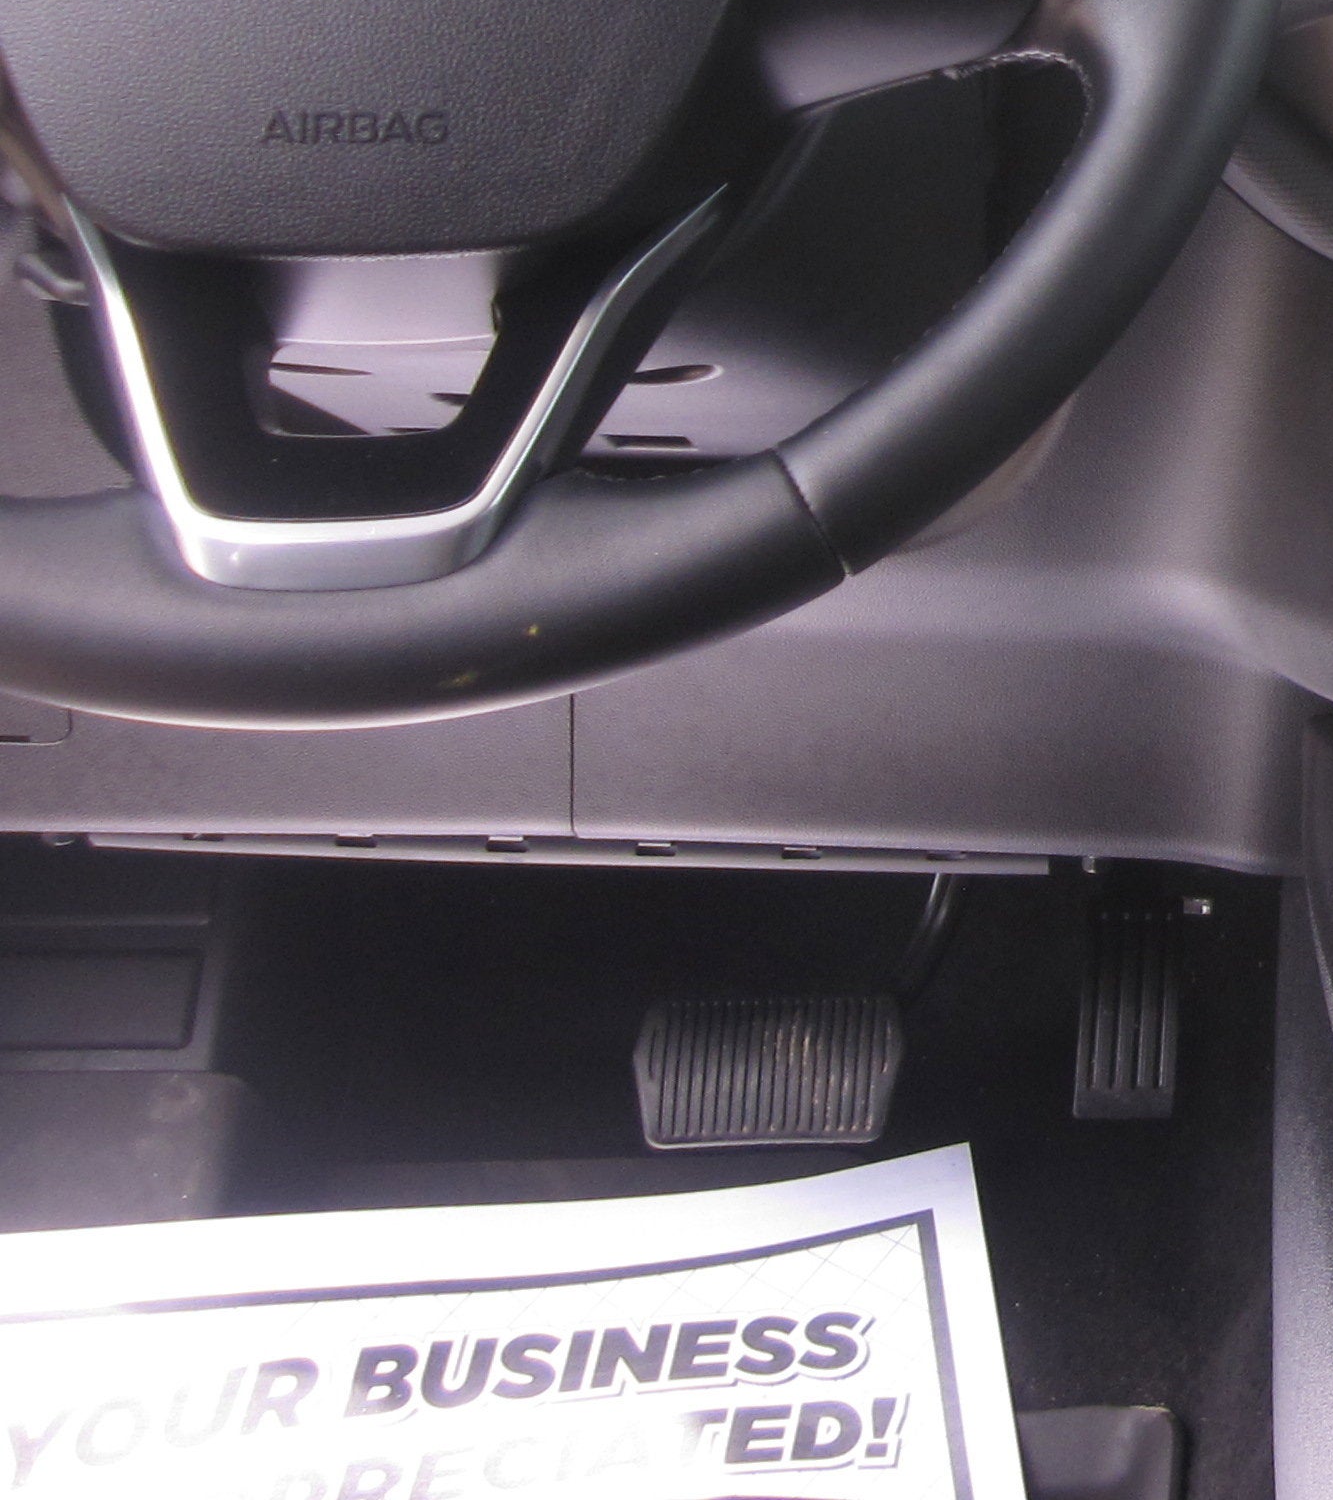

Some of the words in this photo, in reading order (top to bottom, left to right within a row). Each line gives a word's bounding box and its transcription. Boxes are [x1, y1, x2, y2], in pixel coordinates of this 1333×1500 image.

[260, 109, 450, 145] AIRBAG
[7, 1355, 320, 1491] YOUR
[342, 1310, 872, 1420] BUSINESS
